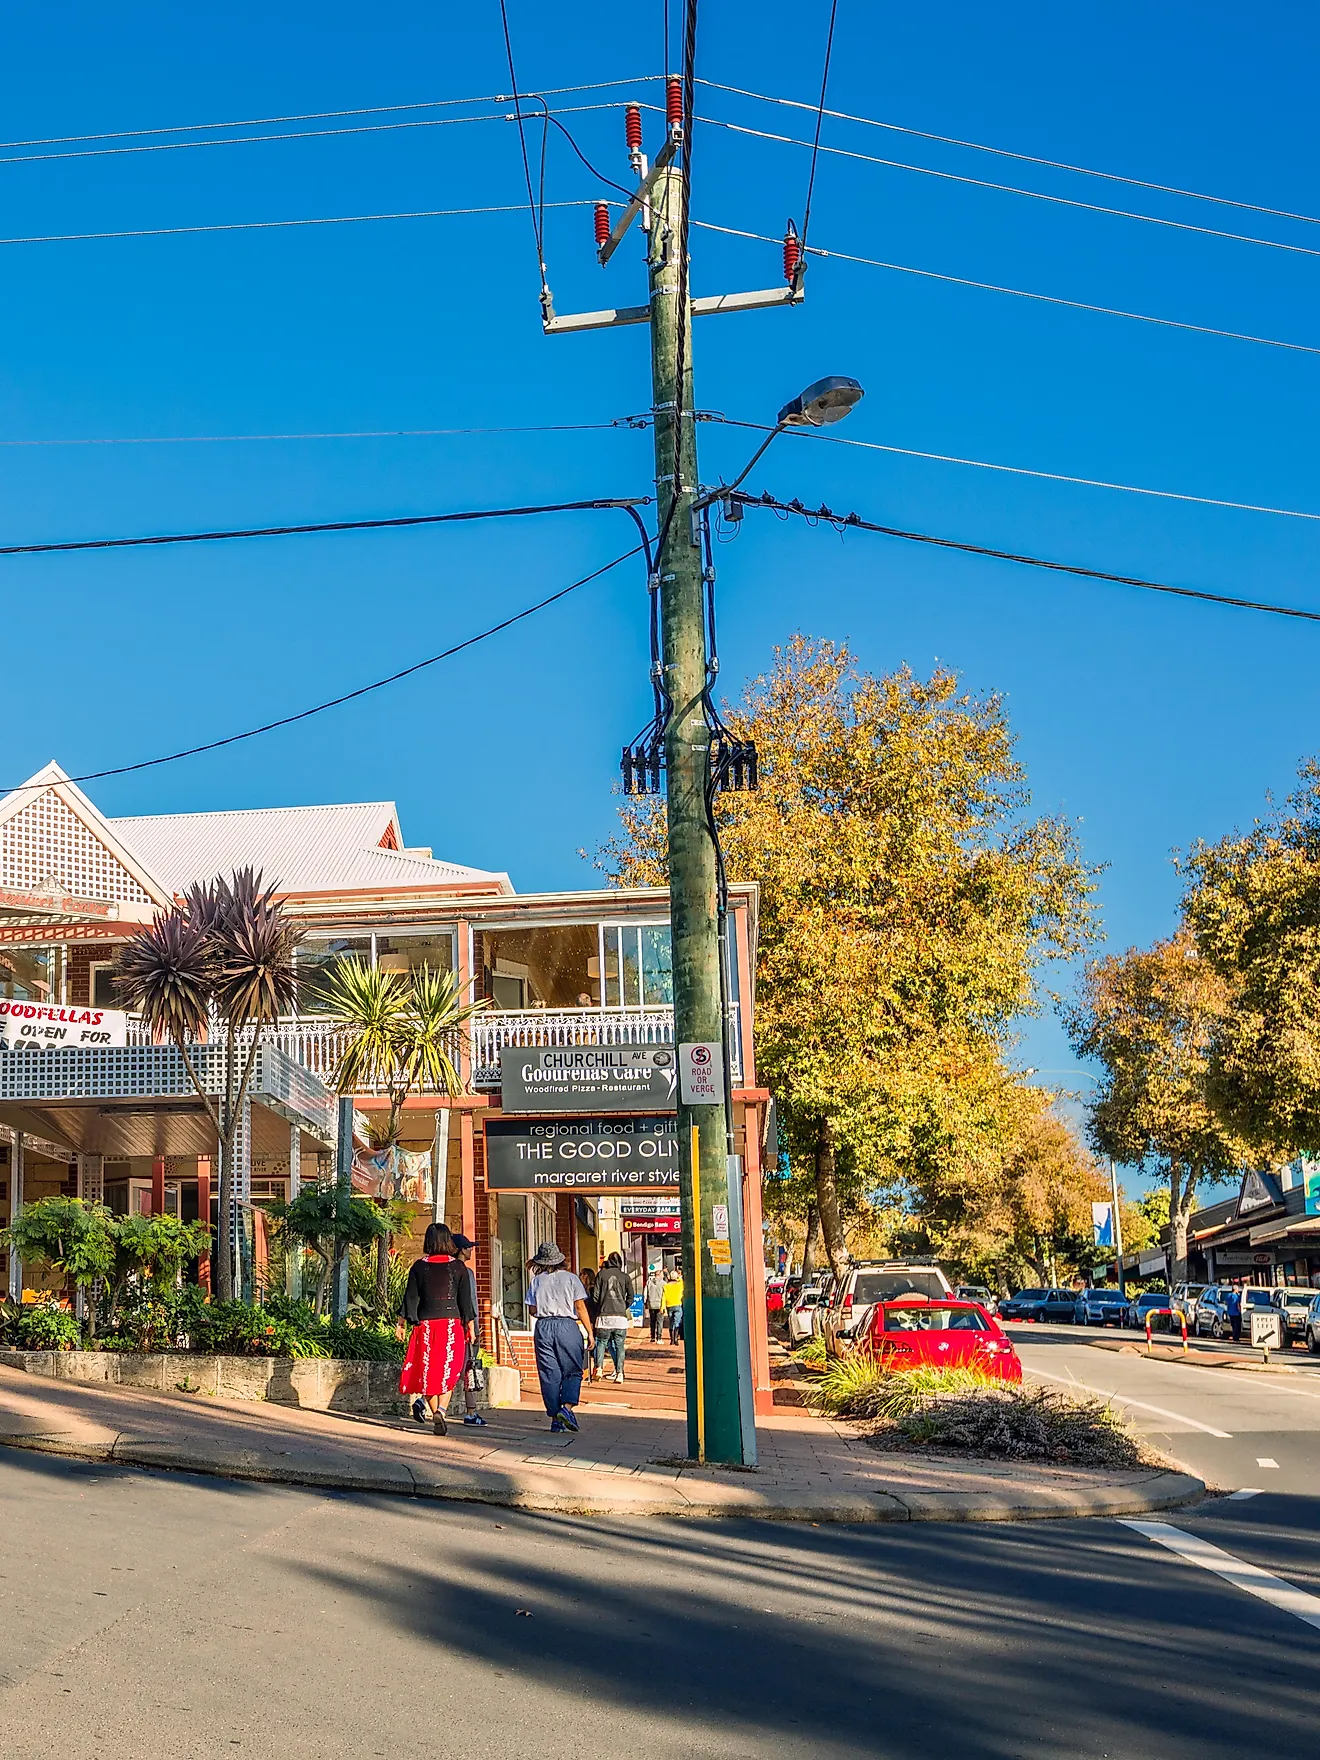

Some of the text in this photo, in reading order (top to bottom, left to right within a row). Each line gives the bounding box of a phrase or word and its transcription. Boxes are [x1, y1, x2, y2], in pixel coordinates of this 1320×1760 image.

[20, 1024, 68, 1040] OPEN
[80, 1030, 112, 1045] FOR
[543, 1051, 647, 1068] CHURCHILL AVE
[691, 1067, 712, 1076] ROAD
[696, 1076, 708, 1084] OR
[524, 1085, 569, 1094] Woodfired
[690, 1084, 715, 1093] VERGE
[530, 1122, 593, 1138] regional
[598, 1121, 635, 1135] food
[516, 1142, 553, 1160] THE
[559, 1141, 632, 1159] GOOD
[534, 1170, 608, 1186] margaret
[611, 1169, 644, 1183] river
[654, 1220, 669, 1228] Bank
